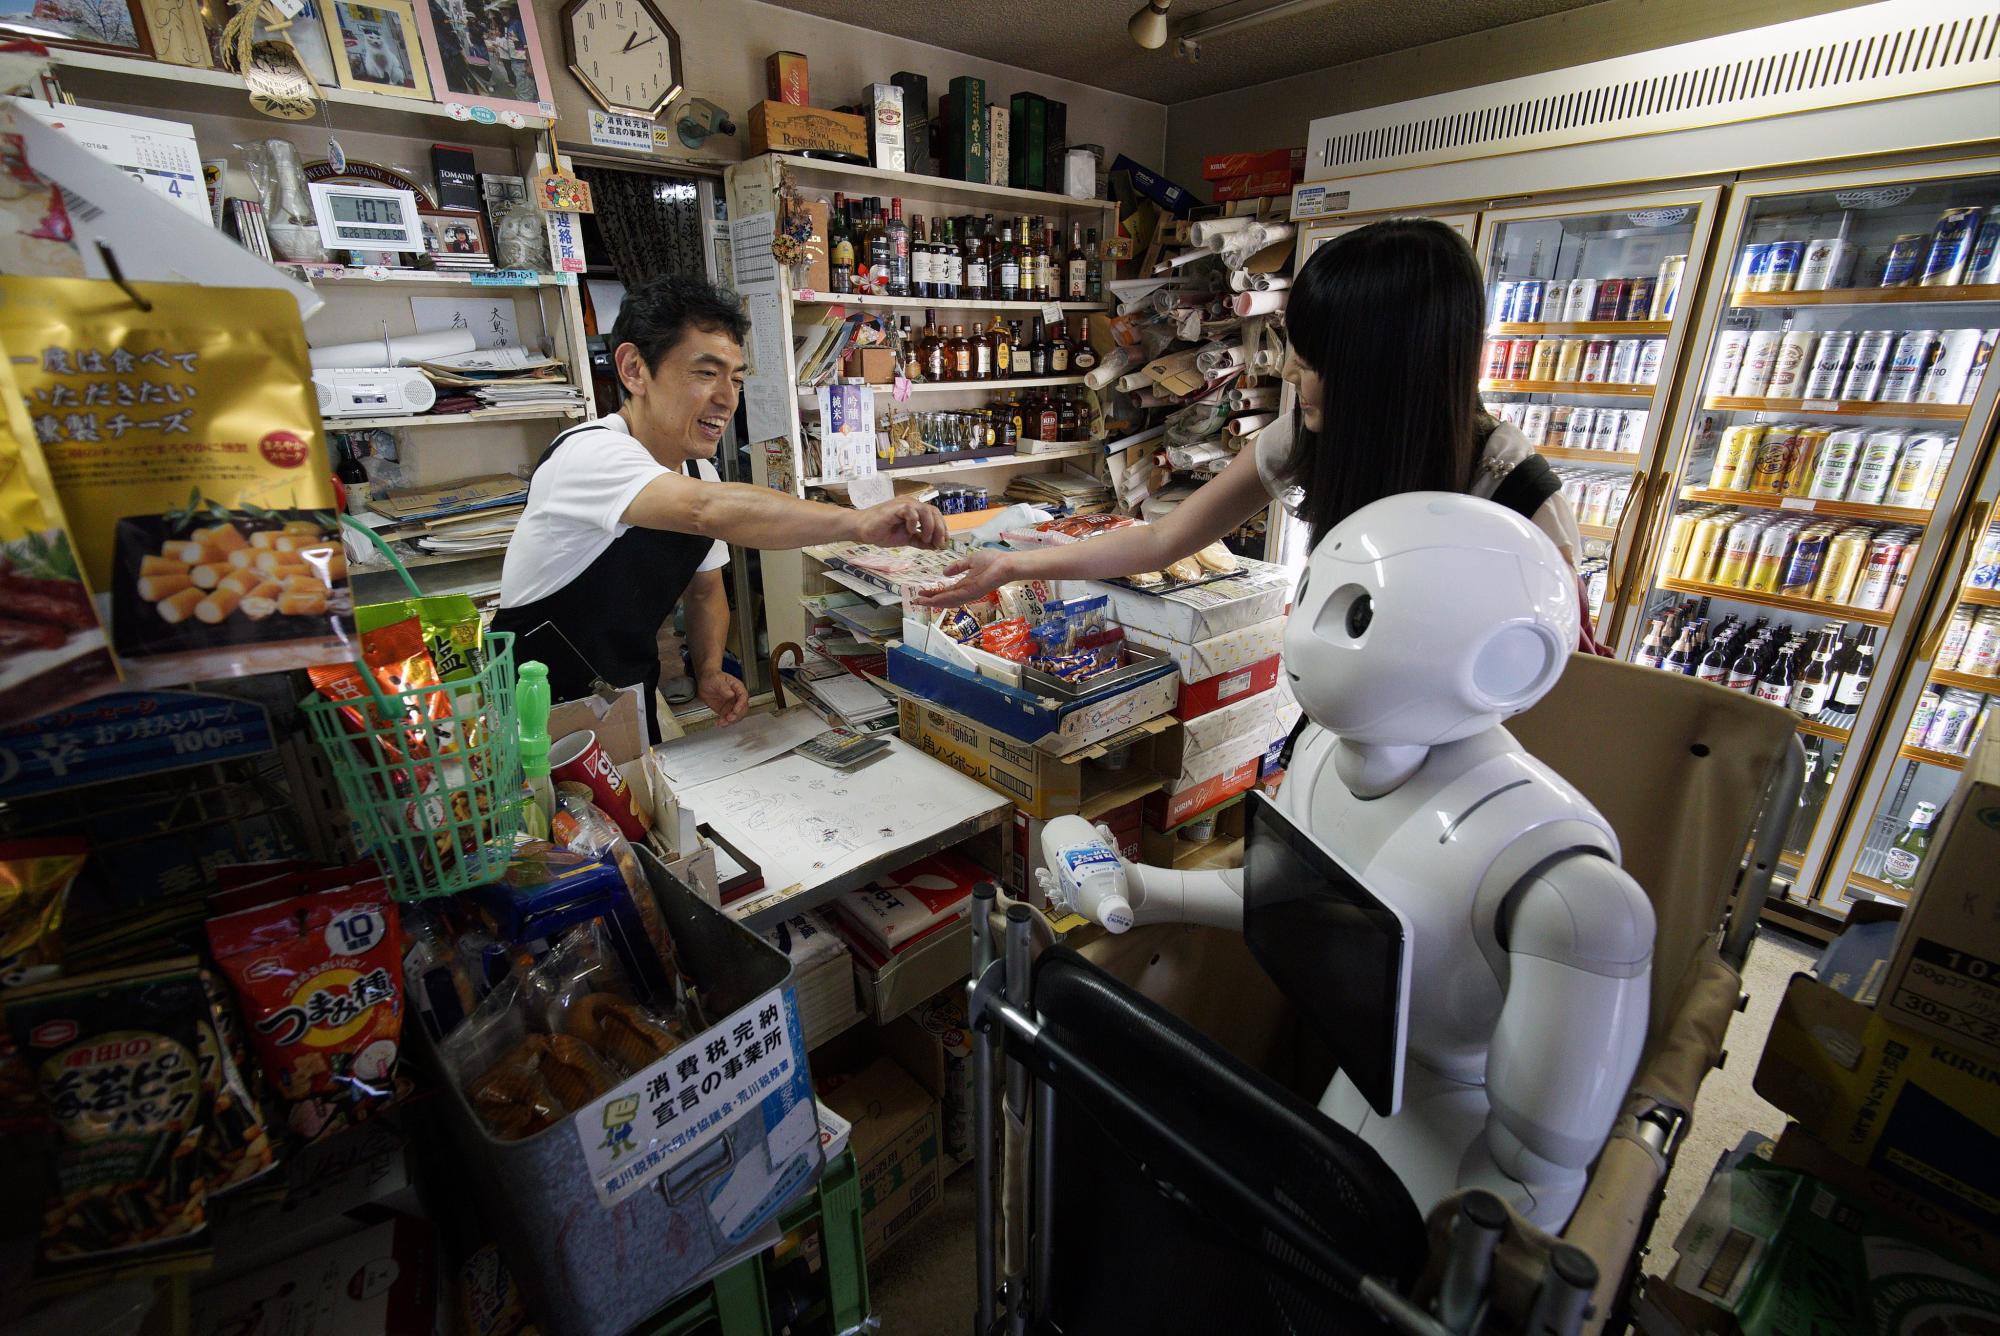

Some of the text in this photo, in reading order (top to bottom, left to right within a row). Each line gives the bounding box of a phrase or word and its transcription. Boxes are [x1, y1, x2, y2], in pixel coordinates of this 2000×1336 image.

[600, 3, 606, 20] 11
[615, 1, 623, 18] 12
[586, 12, 595, 30] 10
[634, 11, 639, 27] 1
[583, 35, 588, 52] 9
[594, 60, 598, 77] 8
[657, 52, 662, 68] 3
[609, 76, 613, 92] 7
[653, 74, 657, 89] 4
[625, 84, 630, 101] 6
[641, 83, 646, 98] 5
[607, 116, 649, 130] 消費税完納
[608, 126, 650, 139] 宣言の事業所
[783, 133, 825, 150] RESERVA
[342, 164, 383, 181] OMPANY
[439, 169, 475, 183] TOMATIN
[168, 179, 183, 198] 4
[356, 199, 391, 223] 1:07
[12, 347, 198, 374] 一度は食べて
[832, 395, 842, 420] 純米
[1043, 416, 1056, 425] RED
[1190, 472, 1214, 482] Asahi
[95, 703, 239, 746] おつまみシリーズ
[169, 726, 245, 754] 100円
[944, 719, 978, 749] Highball
[921, 732, 987, 779] 角ハイボール
[1174, 798, 1194, 815] KIRIN
[332, 913, 373, 943] 10
[256, 966, 395, 1047] つまみ種
[646, 1003, 779, 1103] 消費税完納
[652, 1027, 783, 1129] 宣言の事業所
